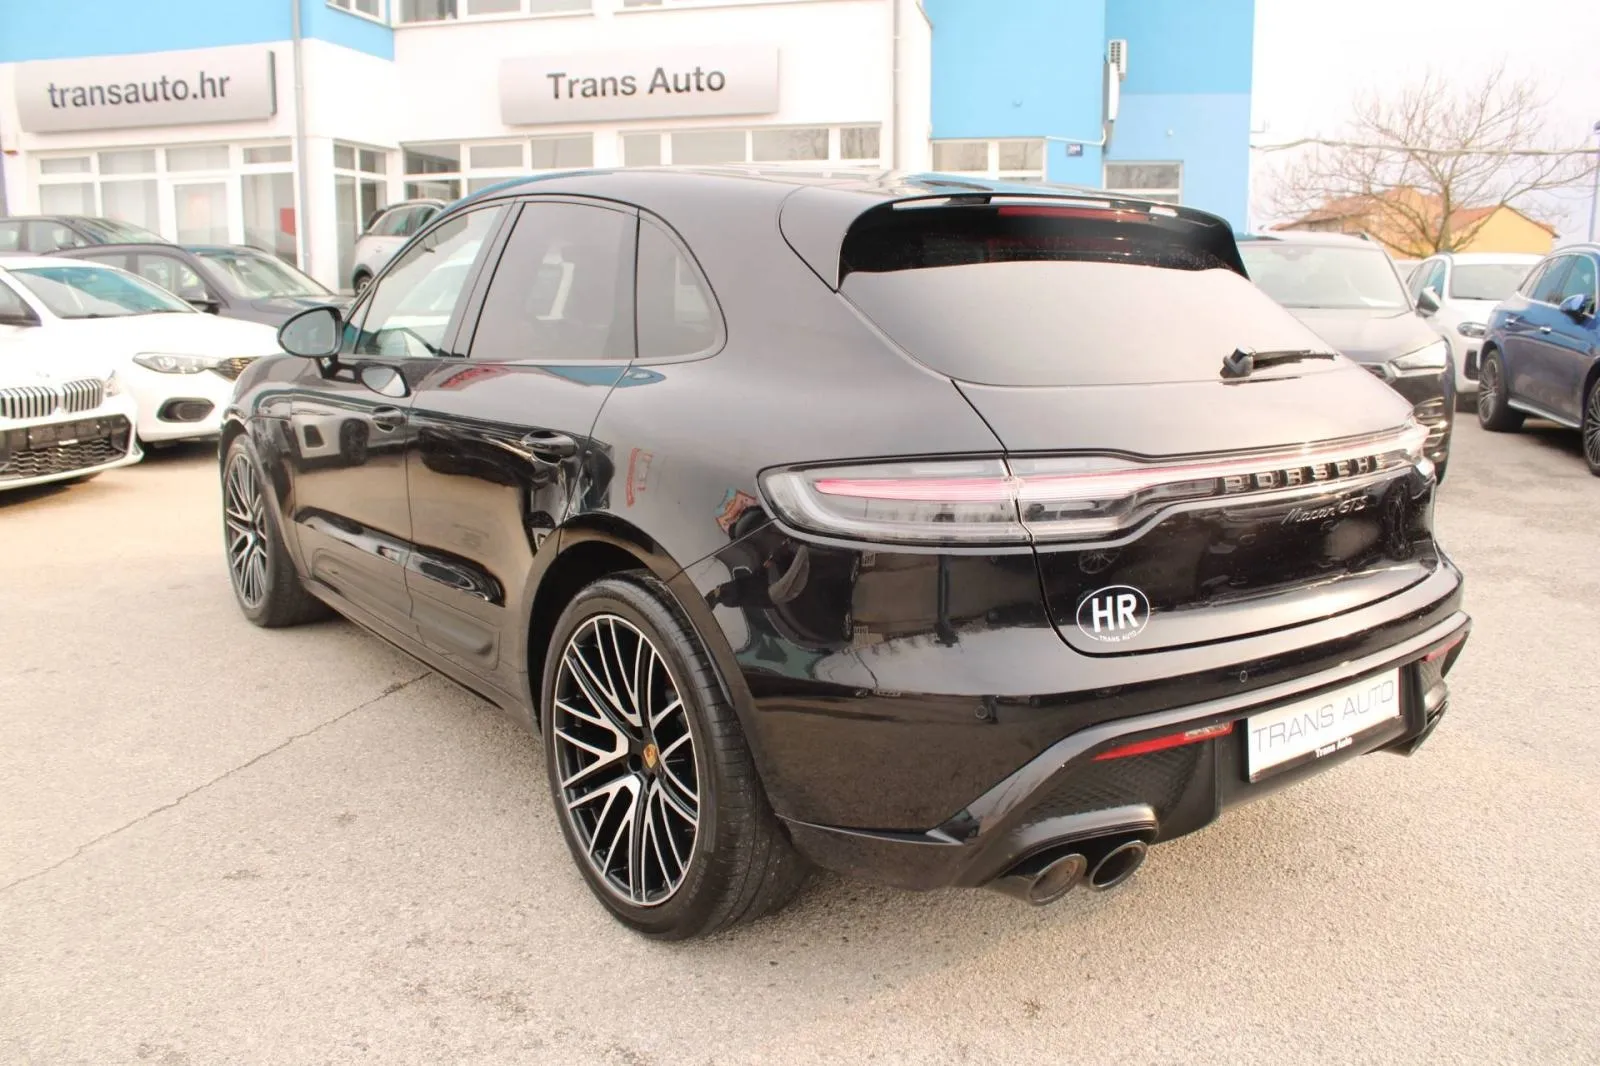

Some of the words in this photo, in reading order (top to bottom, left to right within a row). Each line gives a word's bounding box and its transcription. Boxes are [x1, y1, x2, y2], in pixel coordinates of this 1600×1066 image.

[48, 71, 230, 109] transauto.hr
[546, 72, 637, 99] Trans
[648, 66, 726, 94] Auto
[1224, 455, 1388, 493] PORSCHE
[1281, 506, 1335, 526] Macan
[1337, 495, 1368, 514] GTS
[1092, 593, 1139, 633] HR
[1252, 703, 1334, 752] TRANS
[1342, 679, 1394, 720] AUTO
[1316, 743, 1336, 758] Trans
